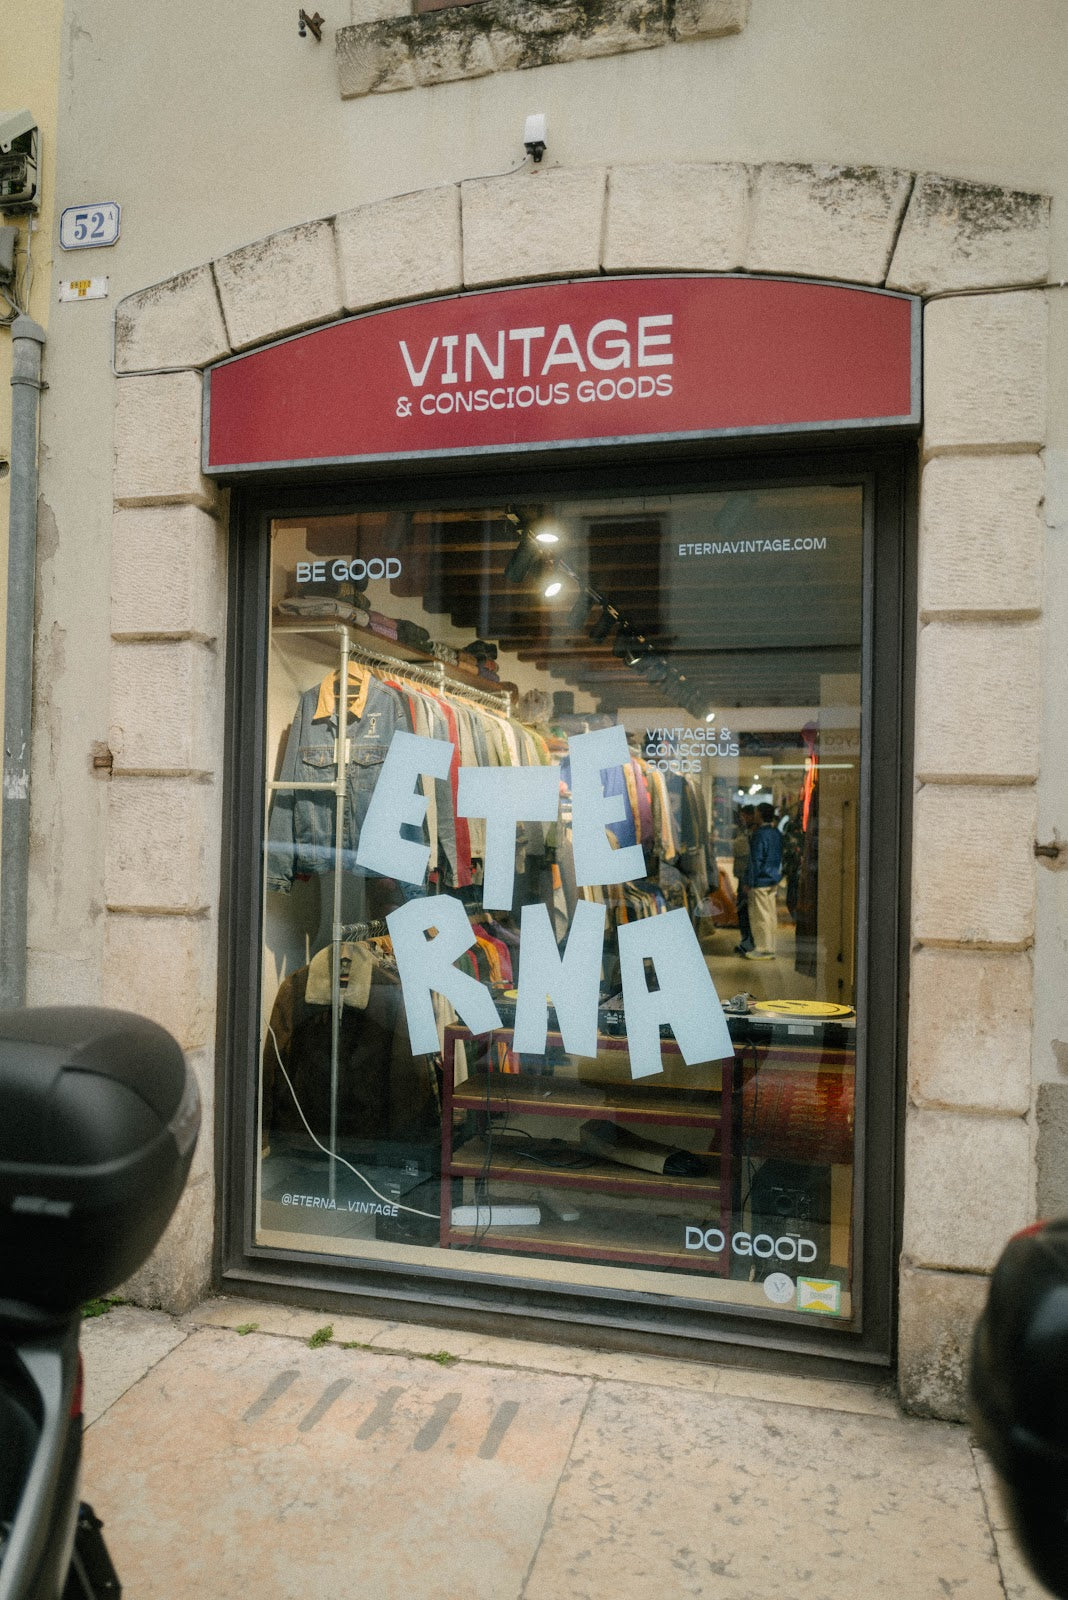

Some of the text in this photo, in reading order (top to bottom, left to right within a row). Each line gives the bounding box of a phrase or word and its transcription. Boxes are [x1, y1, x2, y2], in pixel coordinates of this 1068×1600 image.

[398, 314, 673, 387] VINTAGE
[395, 374, 673, 418] & CONSCIOUS GOODS
[678, 537, 827, 556] ETERNAVINTAGE.COM
[296, 557, 402, 583] BE GOOD
[645, 727, 731, 741] VINTAGE &
[645, 743, 740, 757] CONSCIOUS
[646, 759, 702, 773] GOODS
[281, 1193, 399, 1217] @ETERNA_VINTAGE
[685, 1226, 818, 1263] DO GOOD
